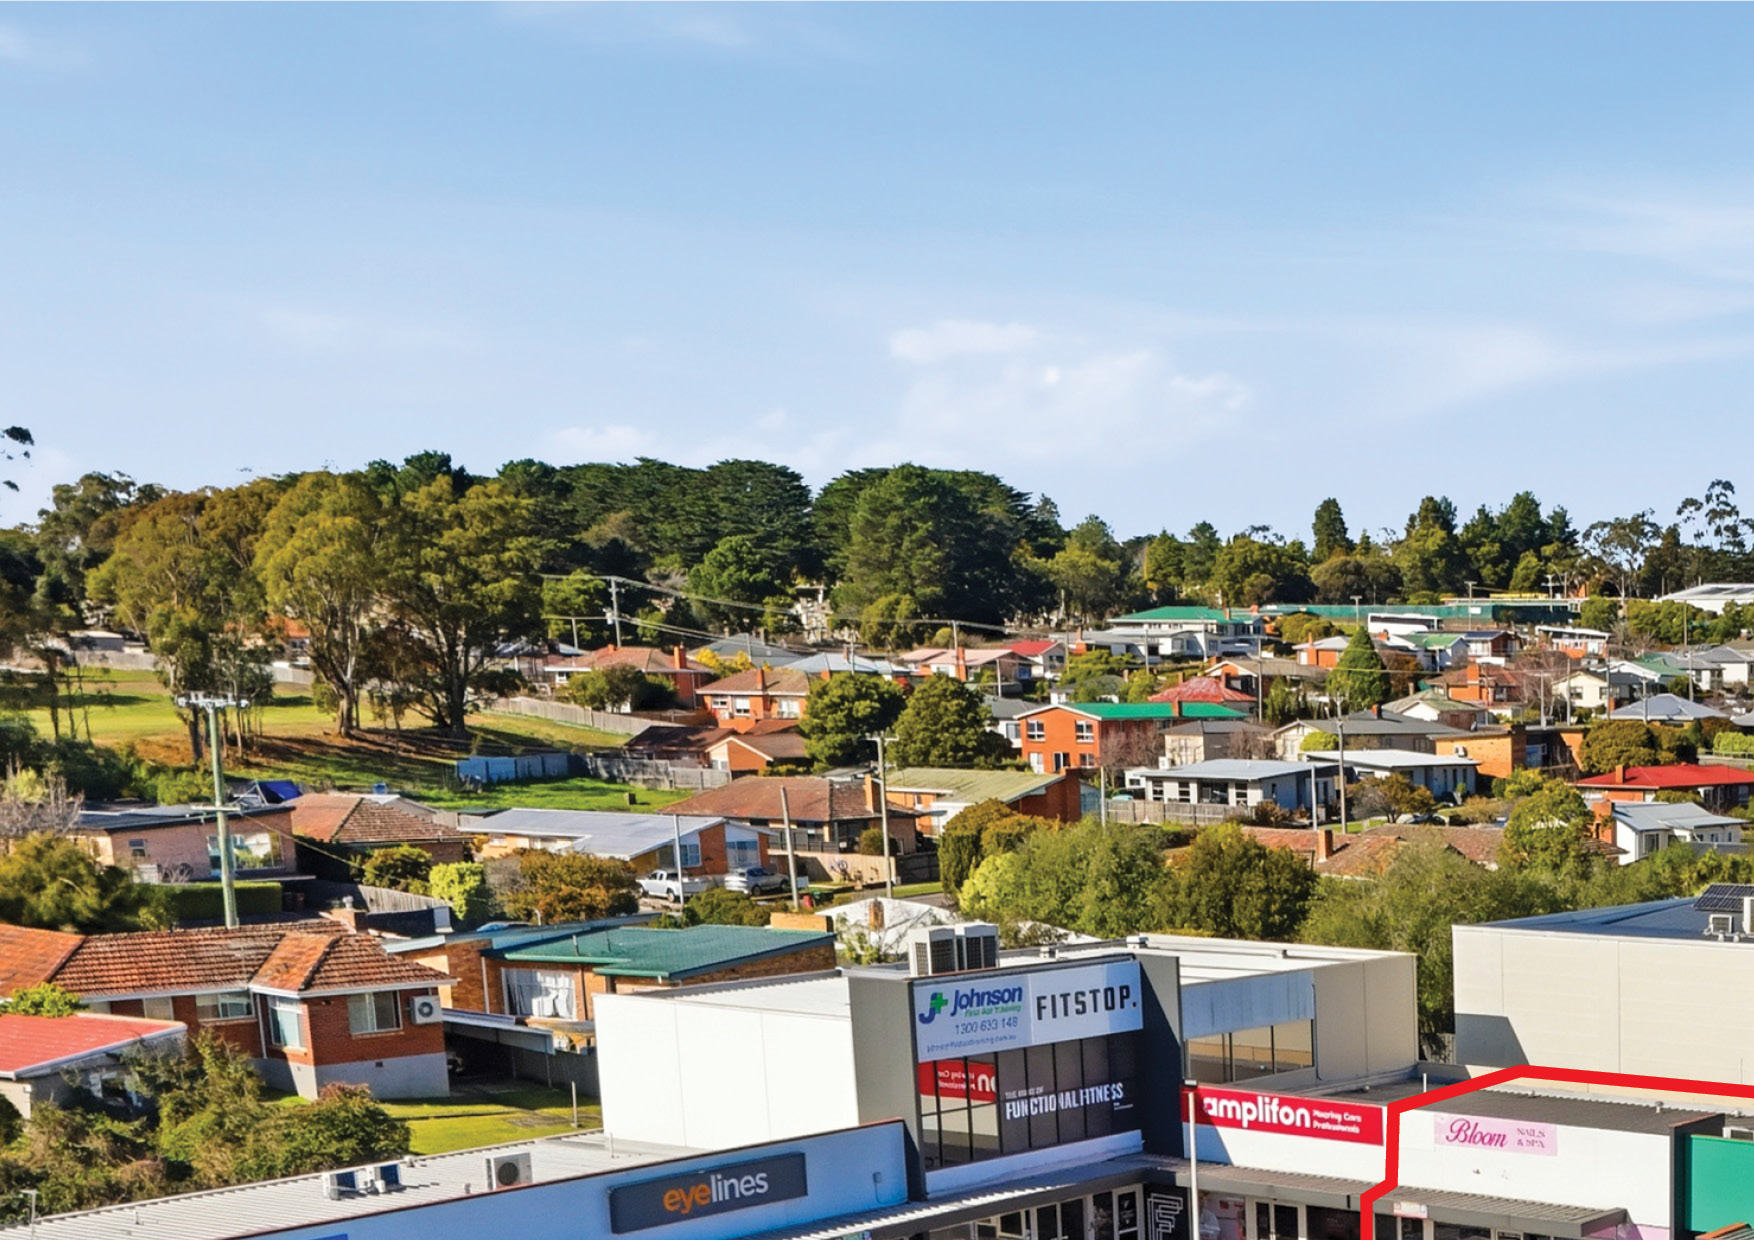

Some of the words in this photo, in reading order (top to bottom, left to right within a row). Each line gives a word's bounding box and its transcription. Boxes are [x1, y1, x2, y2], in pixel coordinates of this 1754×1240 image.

[950, 986, 1023, 1017] Johnson
[1203, 1096, 1311, 1128] amplifon
[1446, 1118, 1508, 1148] Bloom
[663, 1172, 769, 1214] eyelines
